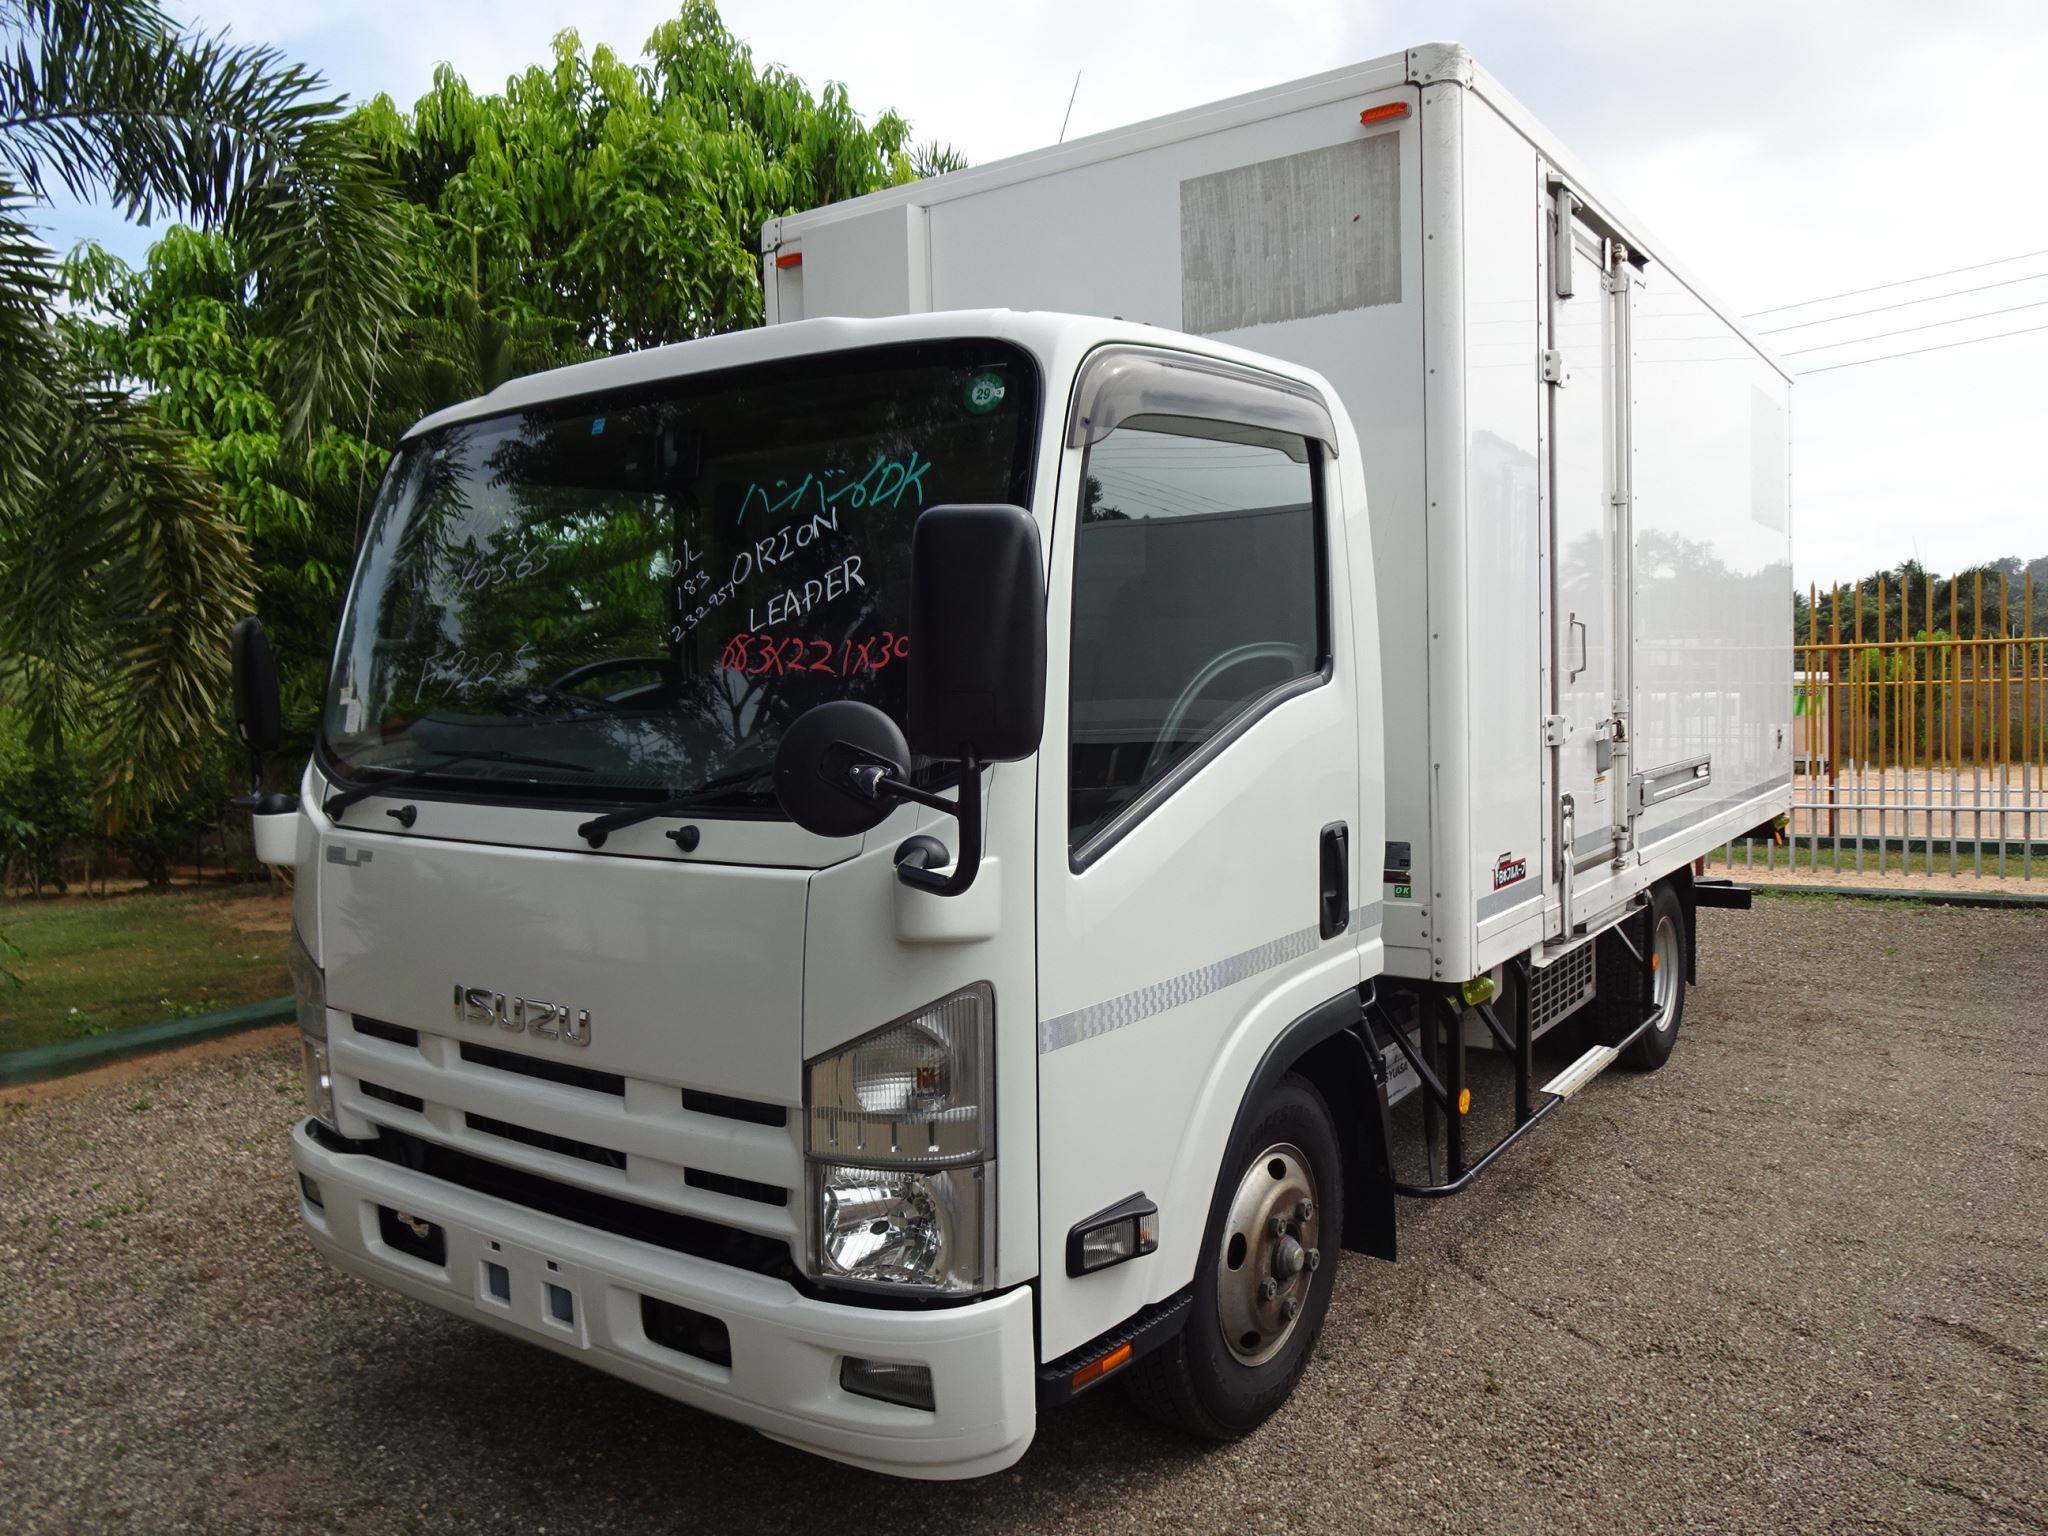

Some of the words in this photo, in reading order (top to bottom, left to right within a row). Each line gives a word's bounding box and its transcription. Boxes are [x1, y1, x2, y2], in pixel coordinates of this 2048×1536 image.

[975, 387, 991, 400] 29
[732, 507, 838, 585] ORION
[750, 555, 865, 632] LEADER
[1395, 886, 1409, 894] OK
[453, 983, 592, 1048] ISUZU
